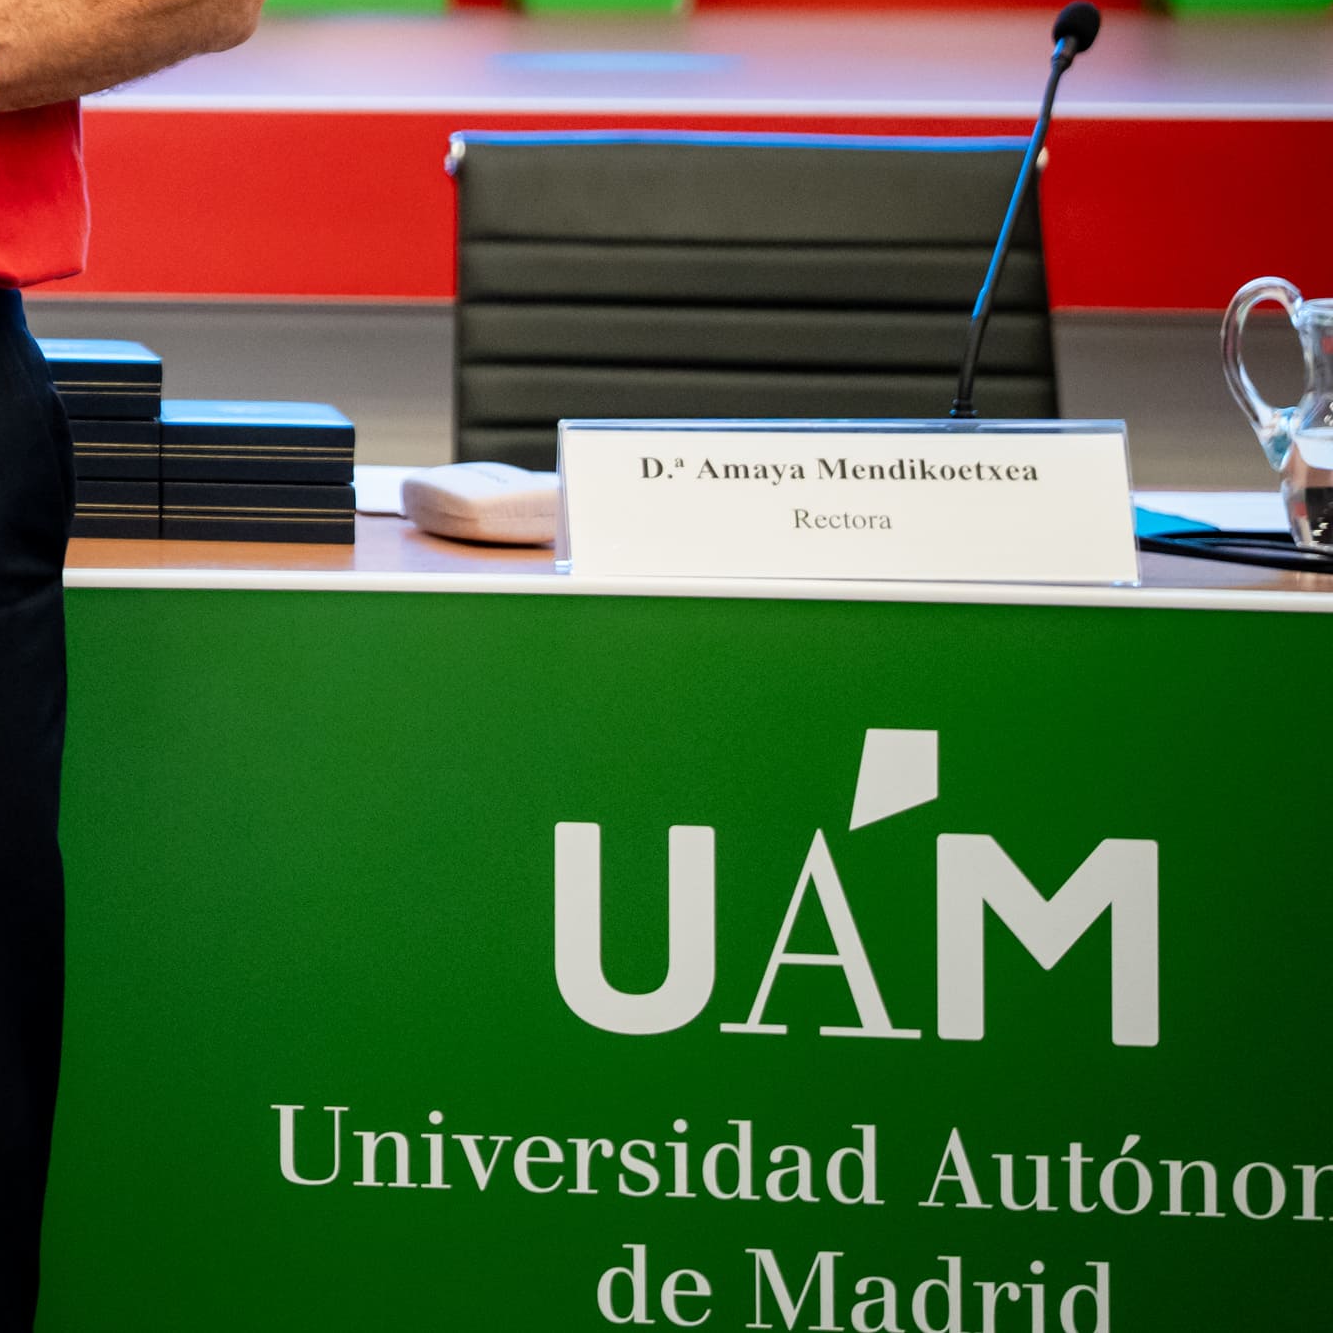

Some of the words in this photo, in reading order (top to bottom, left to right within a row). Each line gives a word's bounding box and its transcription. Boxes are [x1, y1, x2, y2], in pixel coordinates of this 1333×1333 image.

[698, 457, 806, 486] Amaya
[817, 456, 1039, 483] Mendikoetxea
[793, 507, 893, 531] Rectora
[270, 1104, 885, 1206] Universidad
[597, 1244, 714, 1327] de
[745, 1248, 1113, 1333] Madrid
